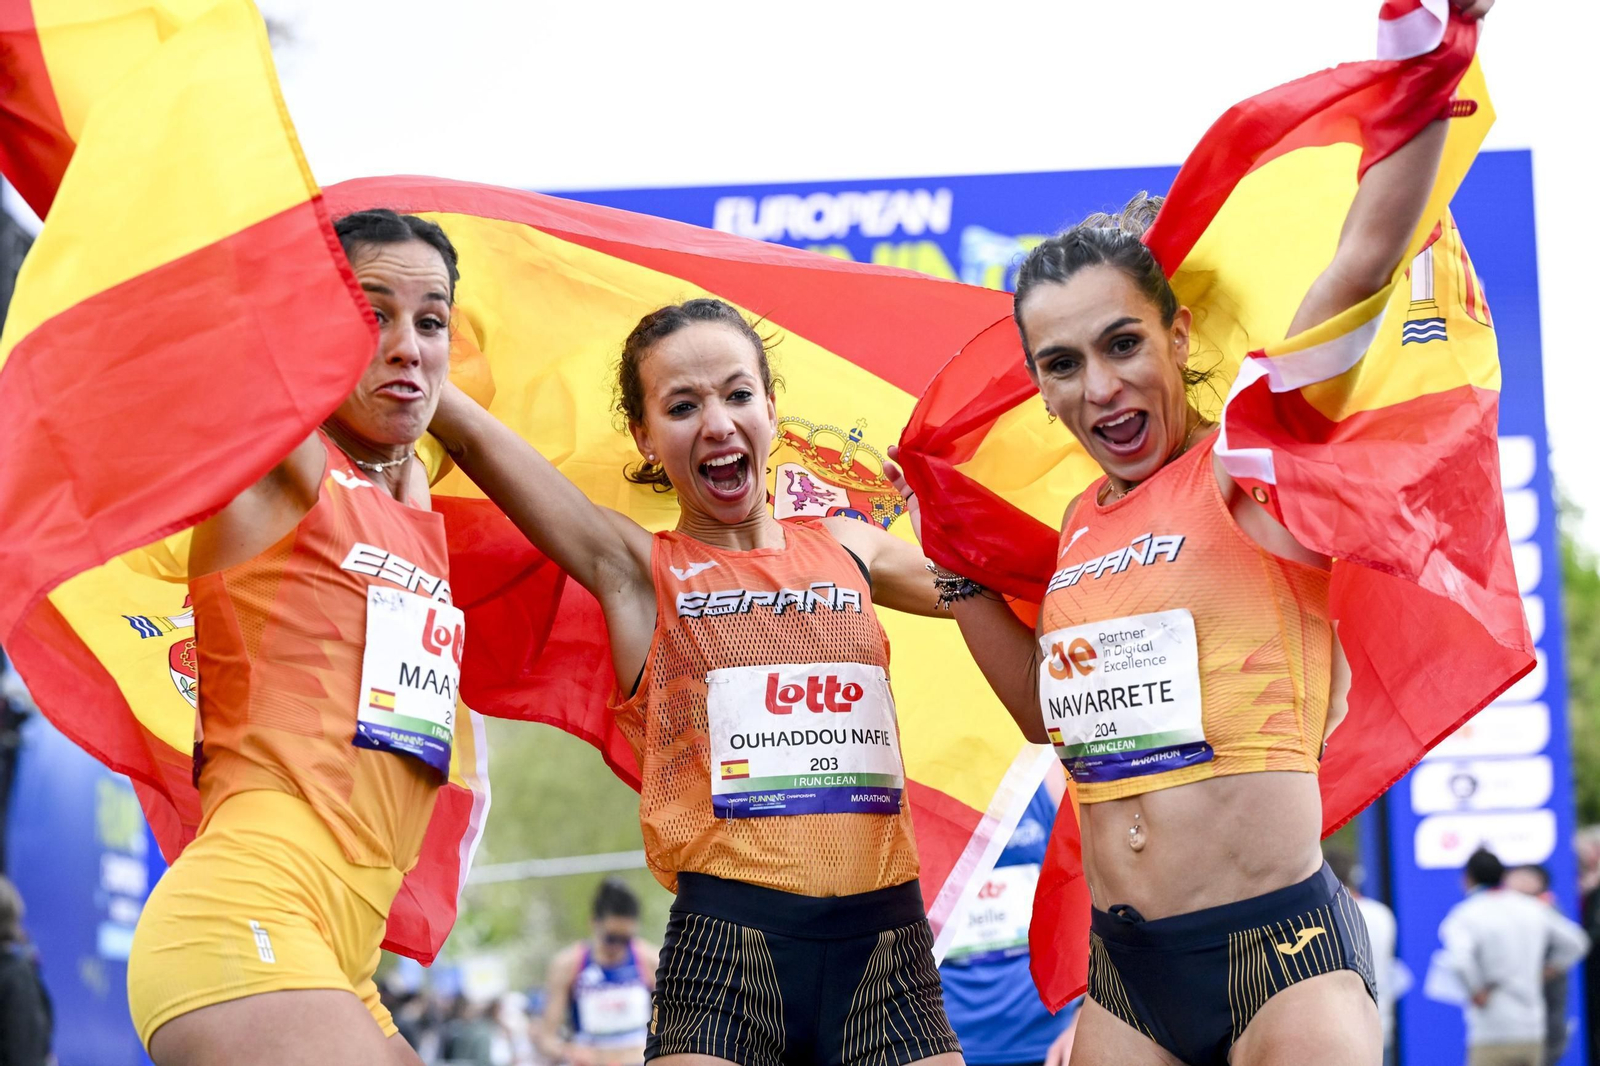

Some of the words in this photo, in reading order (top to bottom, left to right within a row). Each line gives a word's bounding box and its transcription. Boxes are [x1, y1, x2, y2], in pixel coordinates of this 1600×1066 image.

[713, 187, 953, 240] EUROPEAN
[1045, 533, 1185, 596] ESPAÑA
[340, 542, 452, 606] ESPA
[676, 582, 862, 618] ESPAÑA
[1098, 628, 1146, 645] Partner
[1103, 648, 1111, 658] in
[1114, 641, 1154, 659] Digital
[1104, 655, 1167, 673] Excellence
[1049, 680, 1175, 720] NAVARRETE
[1094, 721, 1118, 738] 204
[729, 729, 846, 750] OUHADDOU
[851, 729, 890, 747] NAFIE
[1090, 743, 1108, 754] RUN
[1106, 739, 1136, 753] CLEAN
[809, 757, 839, 772] 203
[1131, 750, 1181, 767] MARATHON
[793, 777, 798, 786] I
[799, 776, 822, 786] RUN
[823, 775, 857, 786] CLEAN
[749, 793, 786, 804] RUNNING
[851, 794, 891, 803] MARATHON
